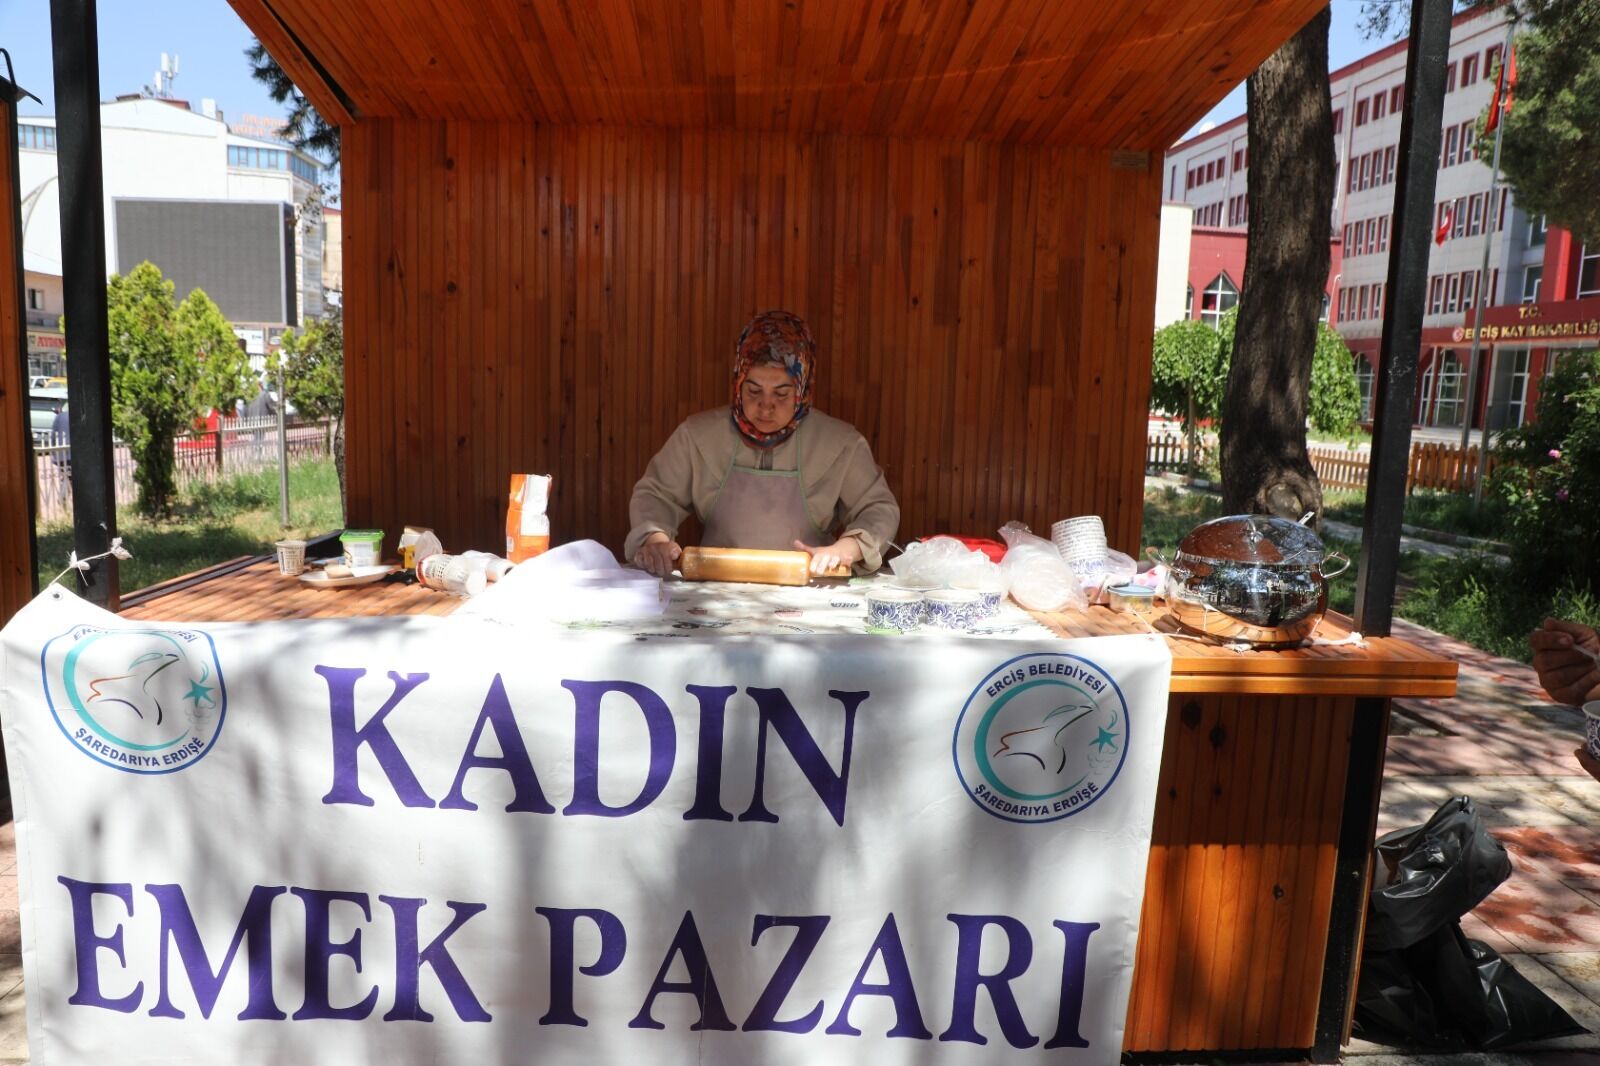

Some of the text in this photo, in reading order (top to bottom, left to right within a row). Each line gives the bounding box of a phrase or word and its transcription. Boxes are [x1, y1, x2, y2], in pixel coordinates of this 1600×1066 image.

[1518, 305, 1542, 319] T.C.
[987, 663, 1108, 698] ERCİŞ BELEDİYESİ
[75, 727, 161, 766] ŞAREDARIYA
[314, 664, 870, 828] KADIN
[974, 783, 1049, 816] ŞAREDARIYA
[57, 875, 1101, 1050] EMEK PAZARI
